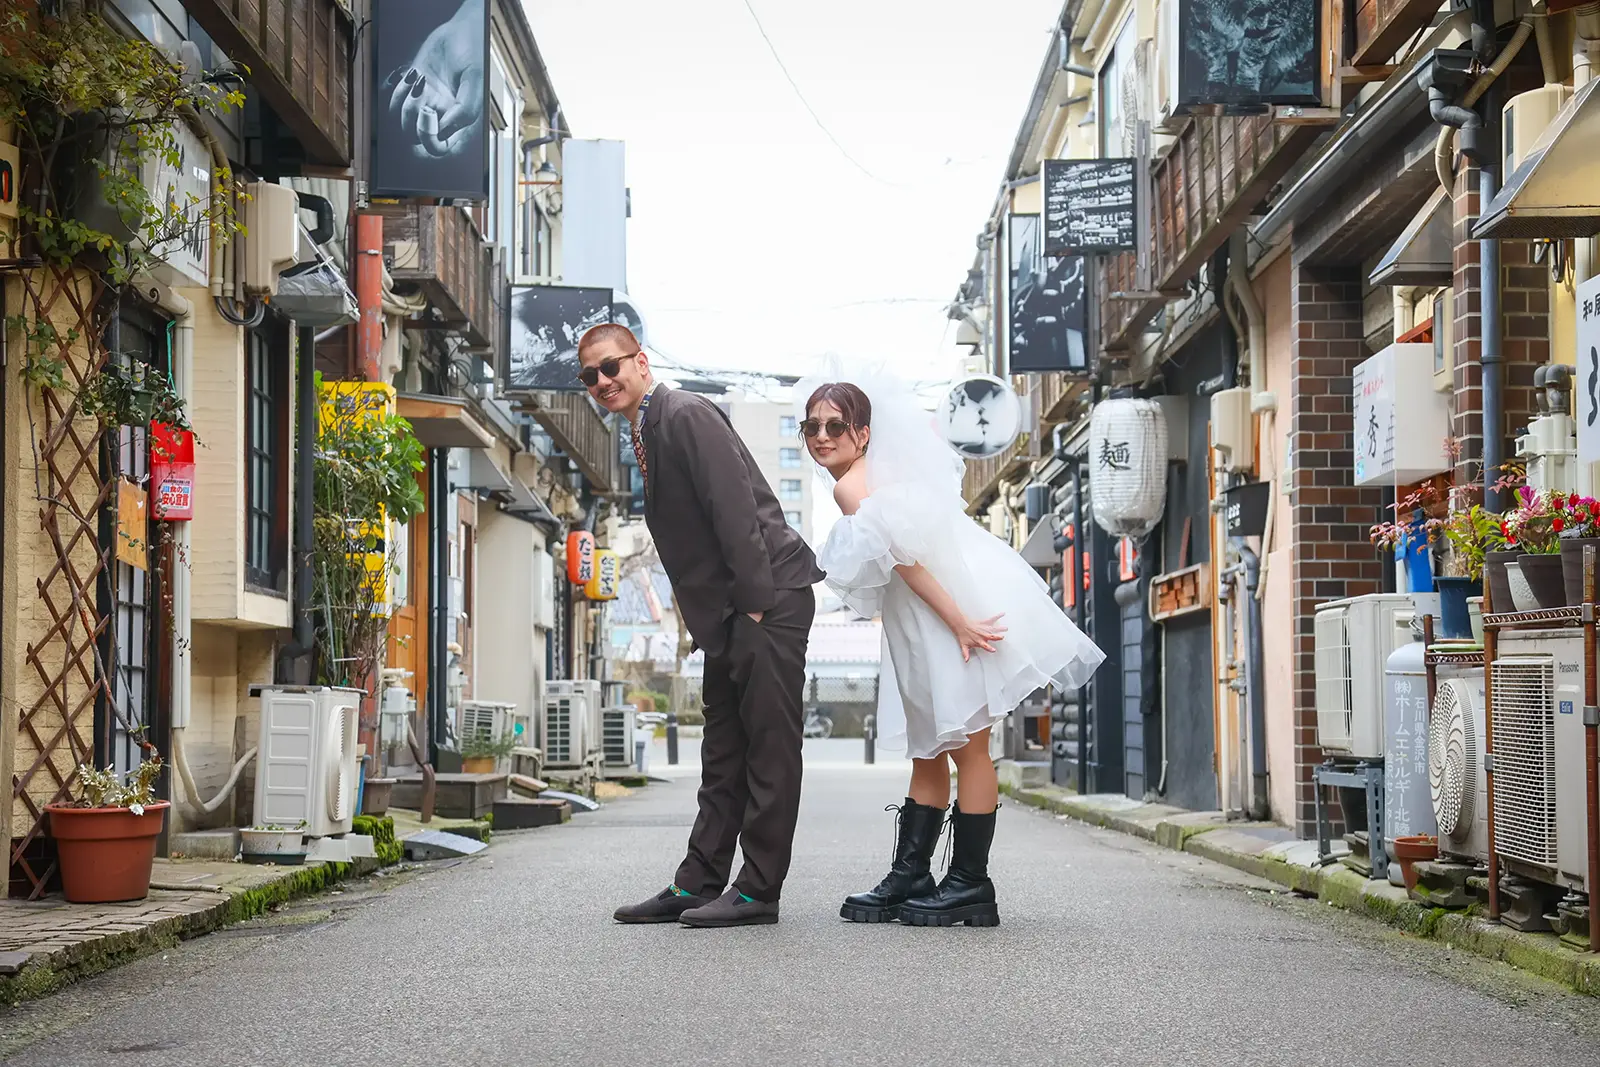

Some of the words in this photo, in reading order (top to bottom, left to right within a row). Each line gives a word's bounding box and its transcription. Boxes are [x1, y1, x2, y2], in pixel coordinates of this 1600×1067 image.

[1367, 404, 1379, 458] 秀
[1559, 661, 1580, 673] Panasonic
[1414, 696, 1426, 775] 石川県金沢市
